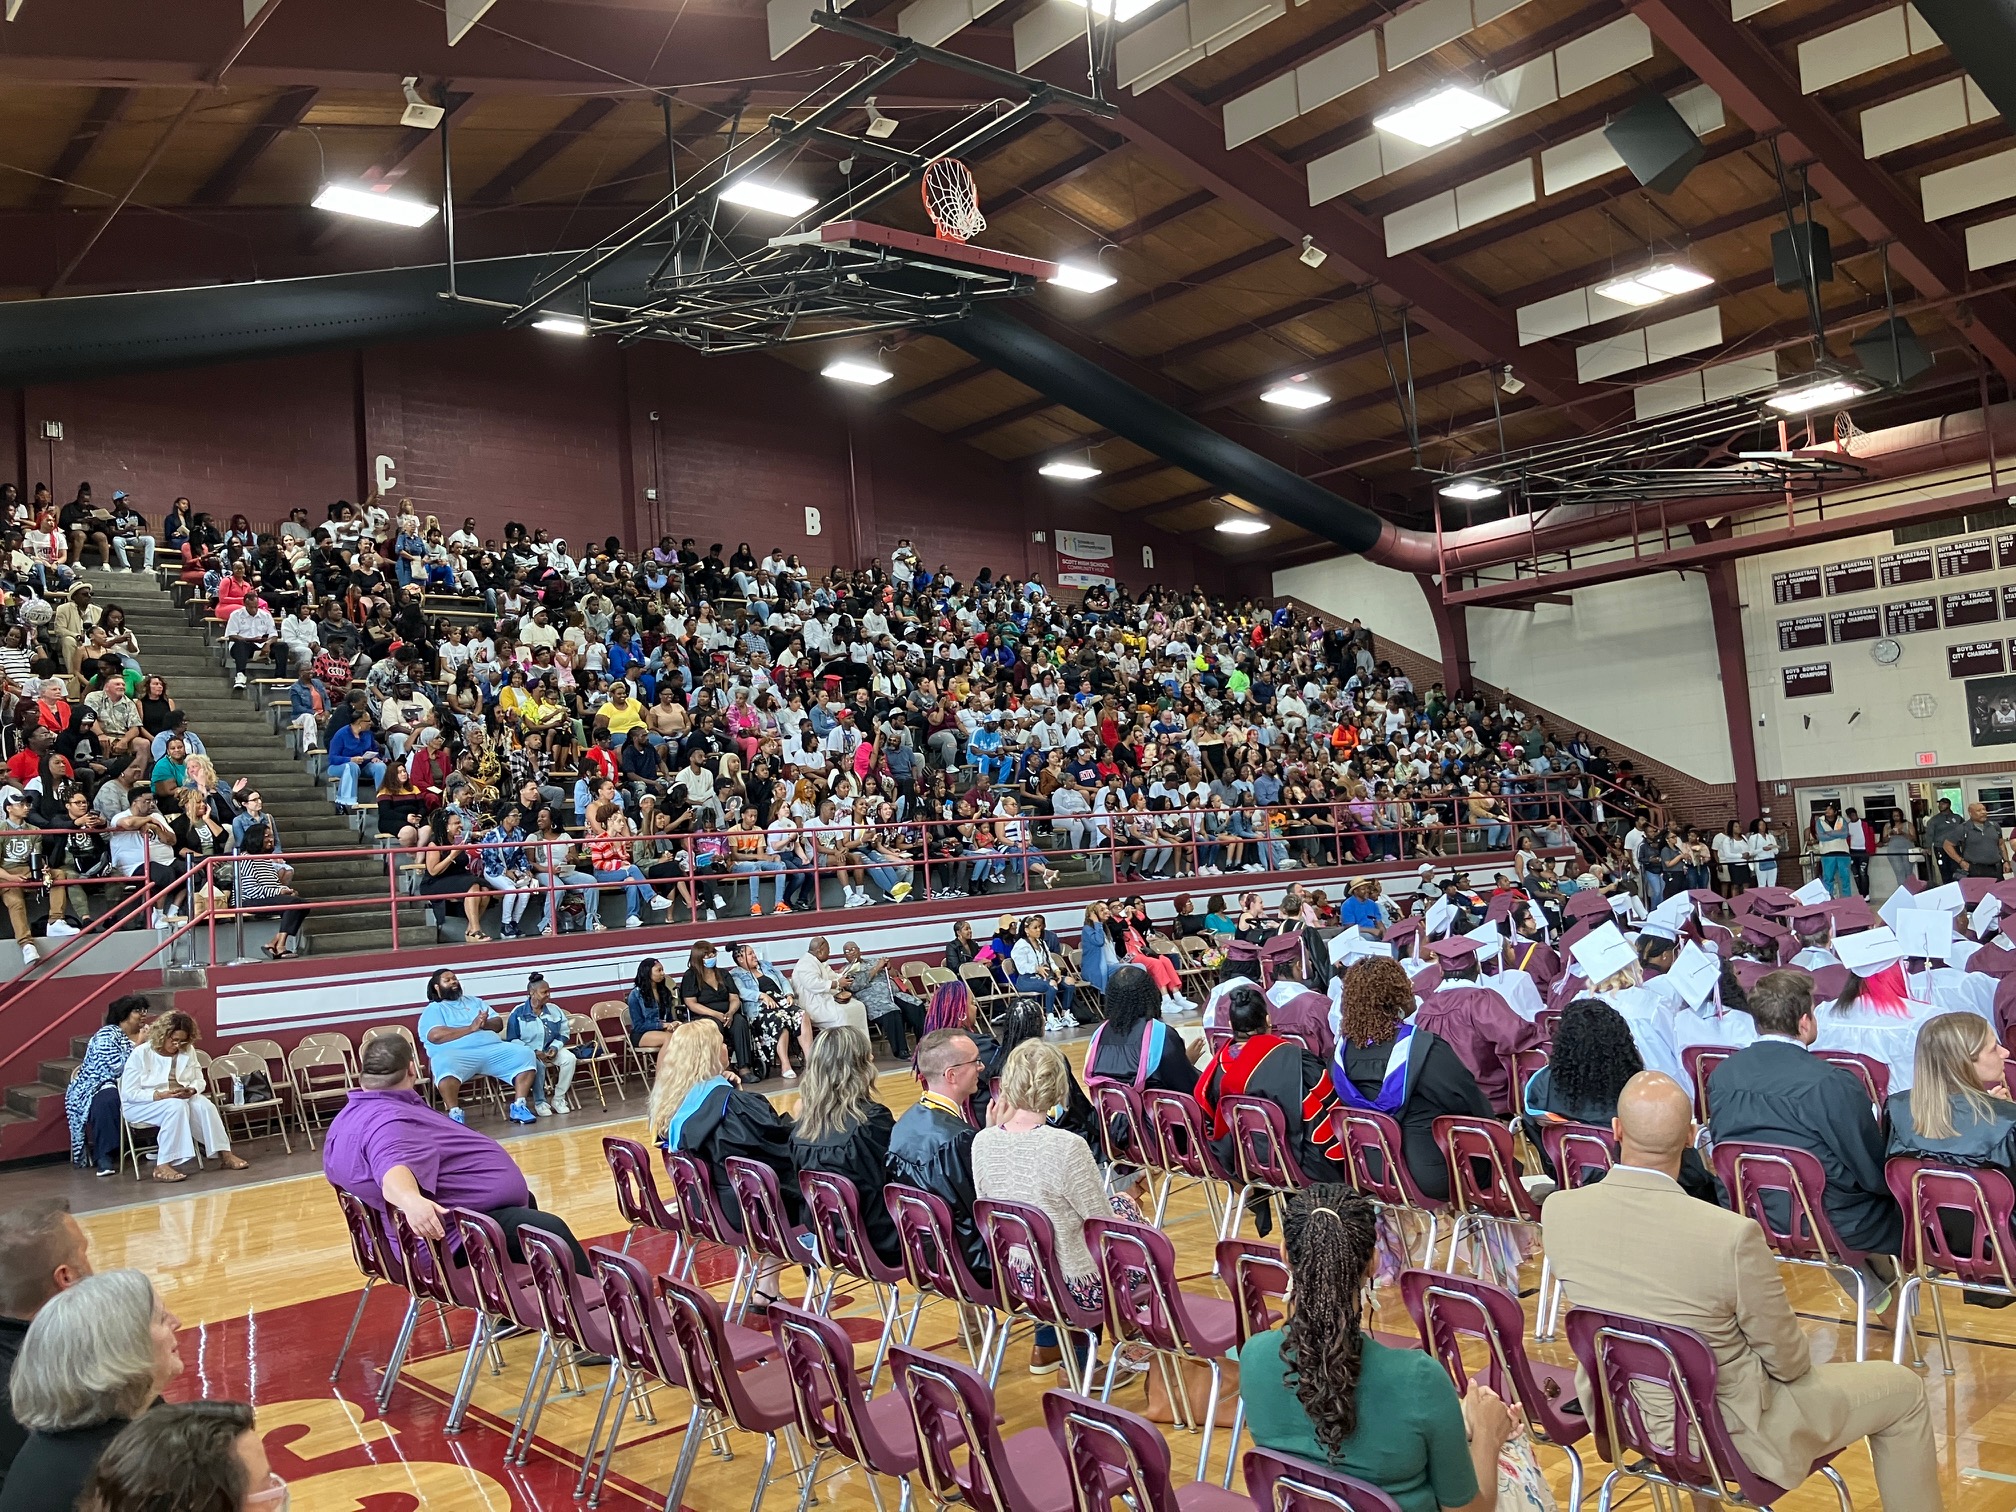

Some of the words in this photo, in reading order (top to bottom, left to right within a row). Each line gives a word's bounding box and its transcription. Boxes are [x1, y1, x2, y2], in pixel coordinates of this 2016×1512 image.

[376, 455, 396, 490] C
[805, 506, 821, 536] B
[1998, 535, 2014, 543] GIRLS
[1938, 545, 1952, 553] BOYS
[1955, 539, 1989, 550] BASKETBALL
[2000, 541, 2014, 549] CITY
[1142, 545, 1154, 569] A
[1896, 549, 1930, 560] BASKETBALL
[1938, 550, 1962, 558] SECTIONAL
[1964, 545, 1990, 554] CHAMPIONS
[1825, 564, 1839, 572] BOYS
[1841, 559, 1872, 569] BASKETBALL
[1881, 560, 1901, 568] DISTRICT
[1903, 555, 1930, 564] CHAMPIONS
[1774, 573, 1787, 581] BOYS
[1788, 569, 1819, 579] BASKETBALL
[1826, 569, 1847, 577] REGIONAL
[1848, 565, 1873, 574] CHAMPIONS
[1789, 574, 1817, 584] CHAMPIONS
[1947, 594, 1966, 602] GIRLS
[1969, 591, 1990, 599] TRACK
[1961, 597, 1993, 606] CHAMPIONS
[1830, 612, 1846, 620] BOYS
[1848, 607, 1878, 617] BASEBALL
[1902, 605, 1933, 615] CHAMPIONS
[1780, 620, 1794, 628] BOYS
[1795, 616, 1824, 625] FOOTBALL
[1847, 614, 1876, 623] CHAMPIONS
[1794, 622, 1822, 631] CHAMPIONS
[1956, 645, 1973, 653] BOYS
[1976, 642, 1993, 650] GOLF
[1952, 652, 1965, 660] CITY
[1967, 648, 1999, 658] CHAMPIONS
[1785, 667, 1800, 675] BOYS
[1802, 664, 1827, 673] BOWLING
[1799, 670, 1827, 679] CHAMPIONS
[1920, 753, 1934, 764] EXIT
